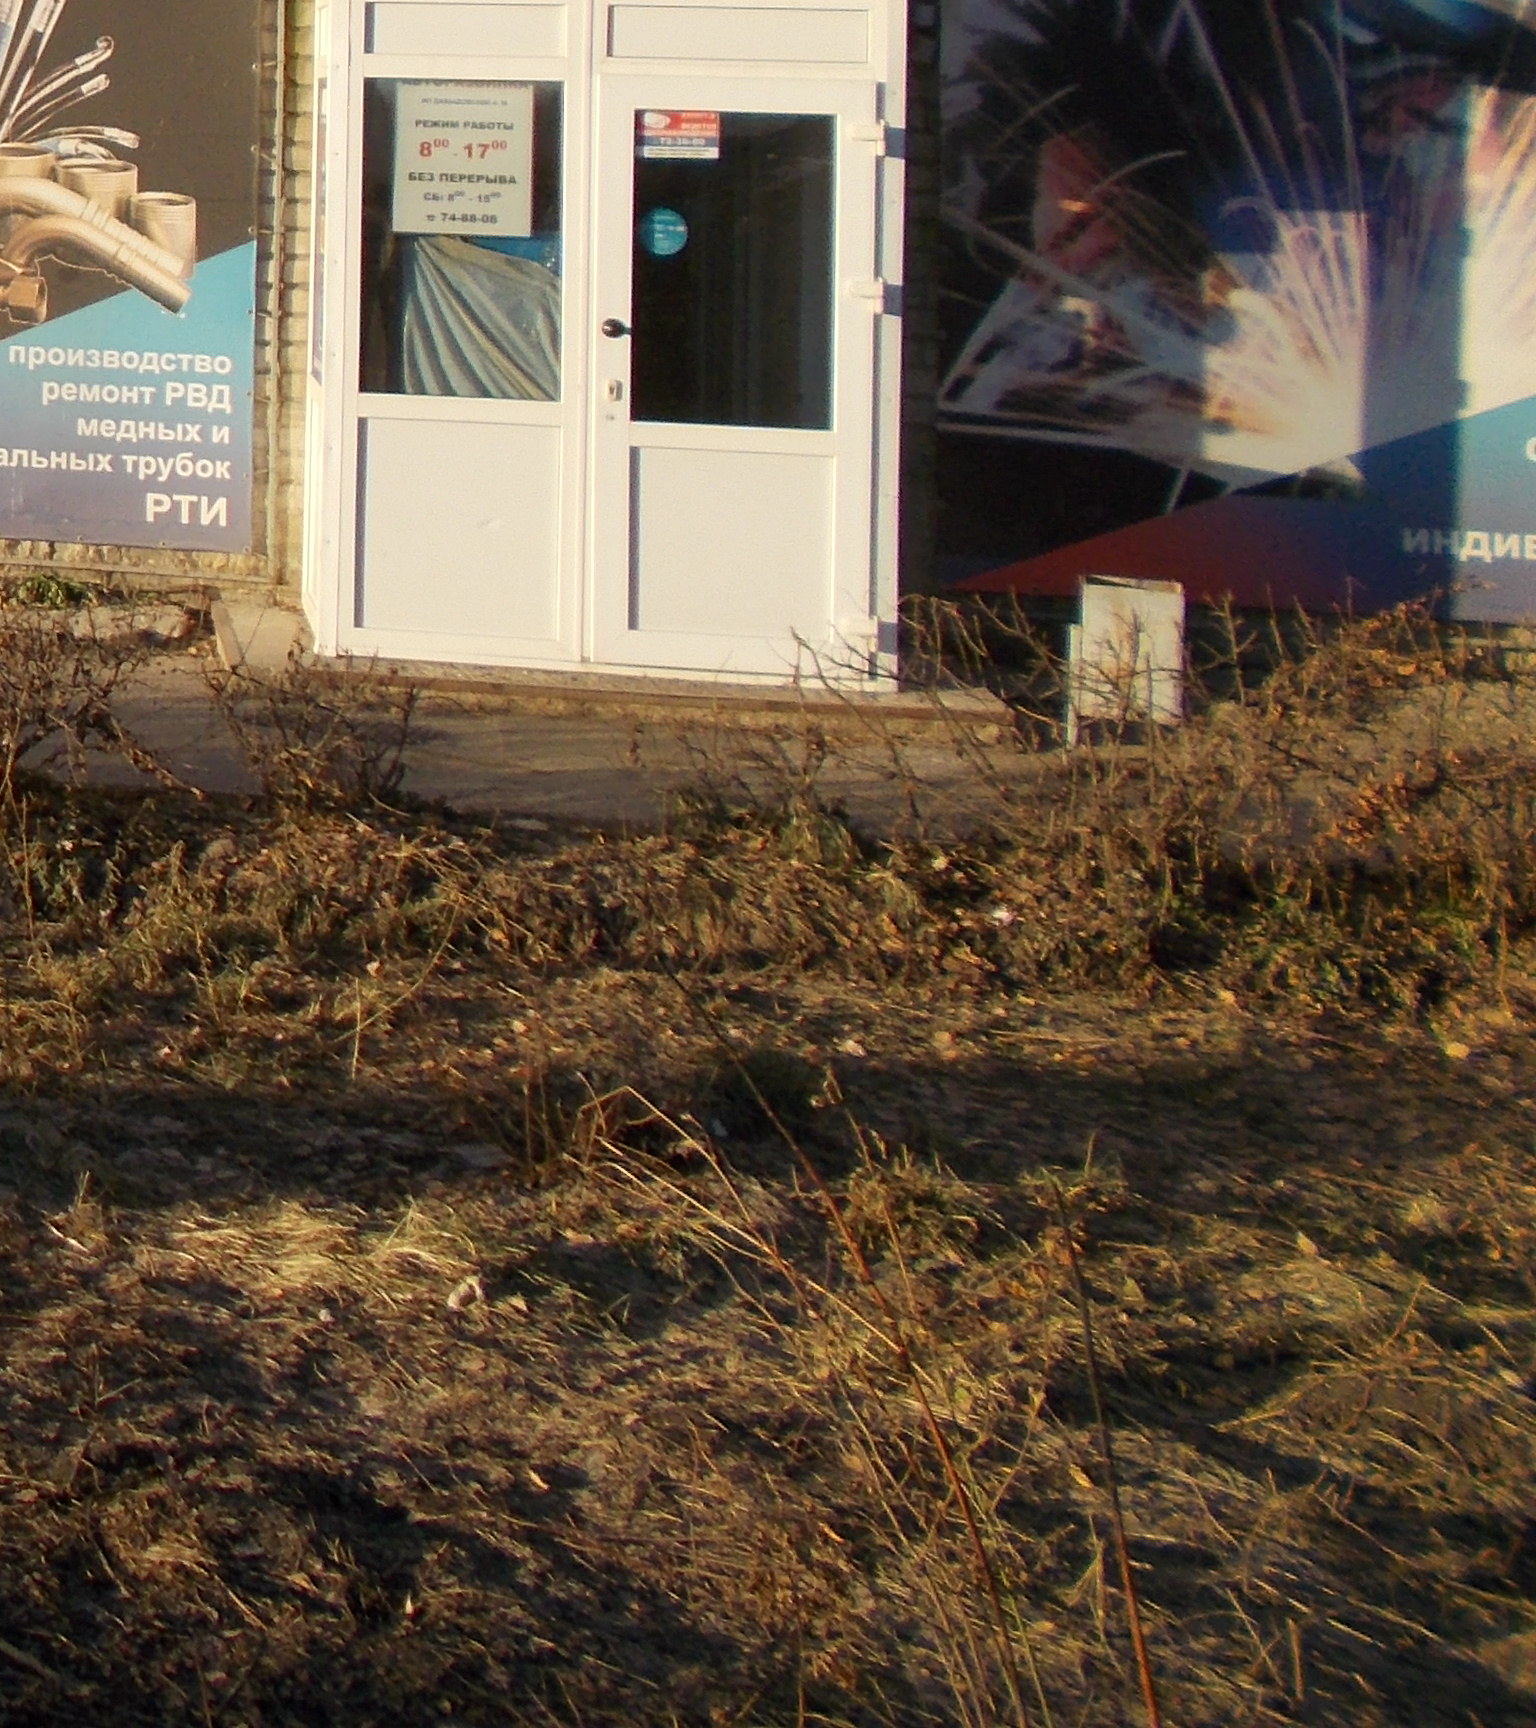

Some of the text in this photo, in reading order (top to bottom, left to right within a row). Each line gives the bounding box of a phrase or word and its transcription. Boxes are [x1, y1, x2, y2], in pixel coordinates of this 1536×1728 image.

[415, 119, 514, 130] РЕЖИМ РАБОТЫ
[408, 172, 517, 184] БЕЗ ПЕРЕРЫВА
[9, 344, 232, 375] производство
[41, 380, 232, 414] ремонт РВД
[77, 418, 230, 444] медных и
[122, 453, 231, 482] трубок
[145, 493, 228, 527] РТИ
